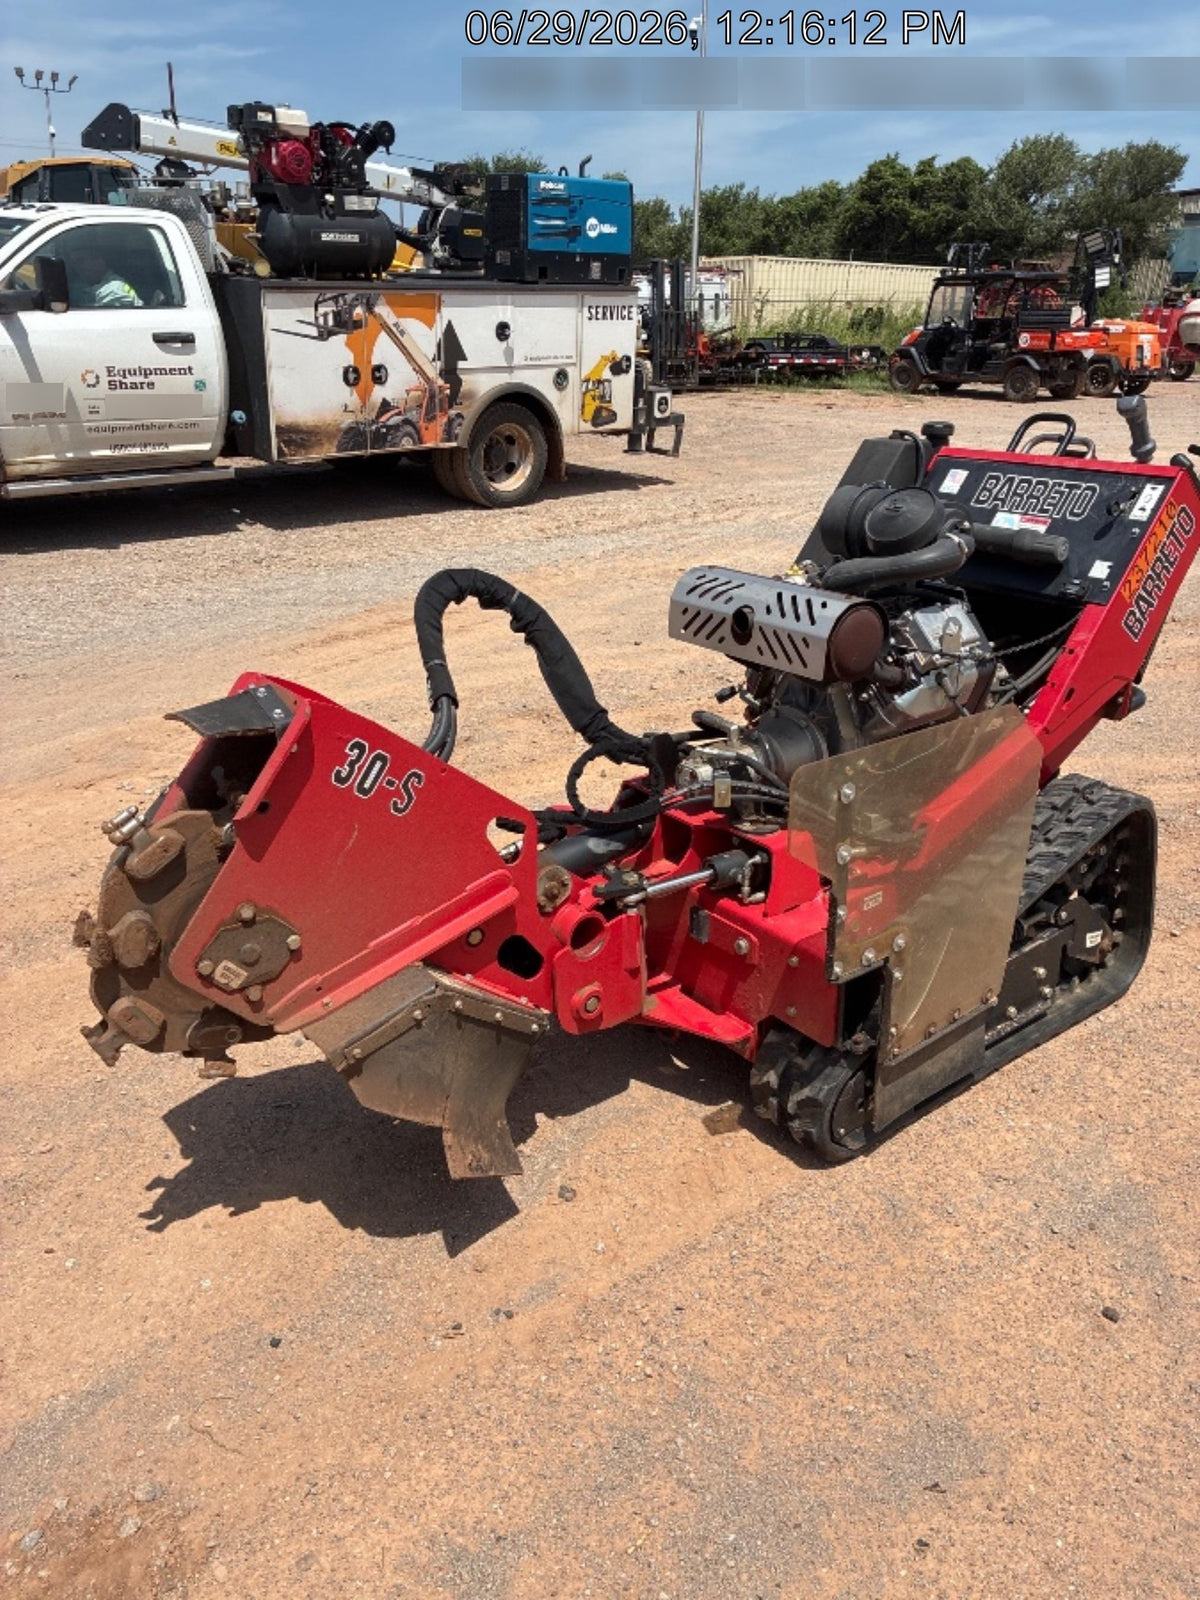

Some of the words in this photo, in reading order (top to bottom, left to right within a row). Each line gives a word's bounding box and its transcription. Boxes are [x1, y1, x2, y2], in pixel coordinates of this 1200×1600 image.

[587, 304, 634, 321] SERVICE
[105, 365, 194, 379] Equipment
[107, 380, 155, 390] Share
[87, 421, 200, 434] equipmentshare.com
[970, 473, 1100, 521] BARRETO
[1122, 504, 1195, 642] BARRETO
[332, 738, 425, 816] 30-S
